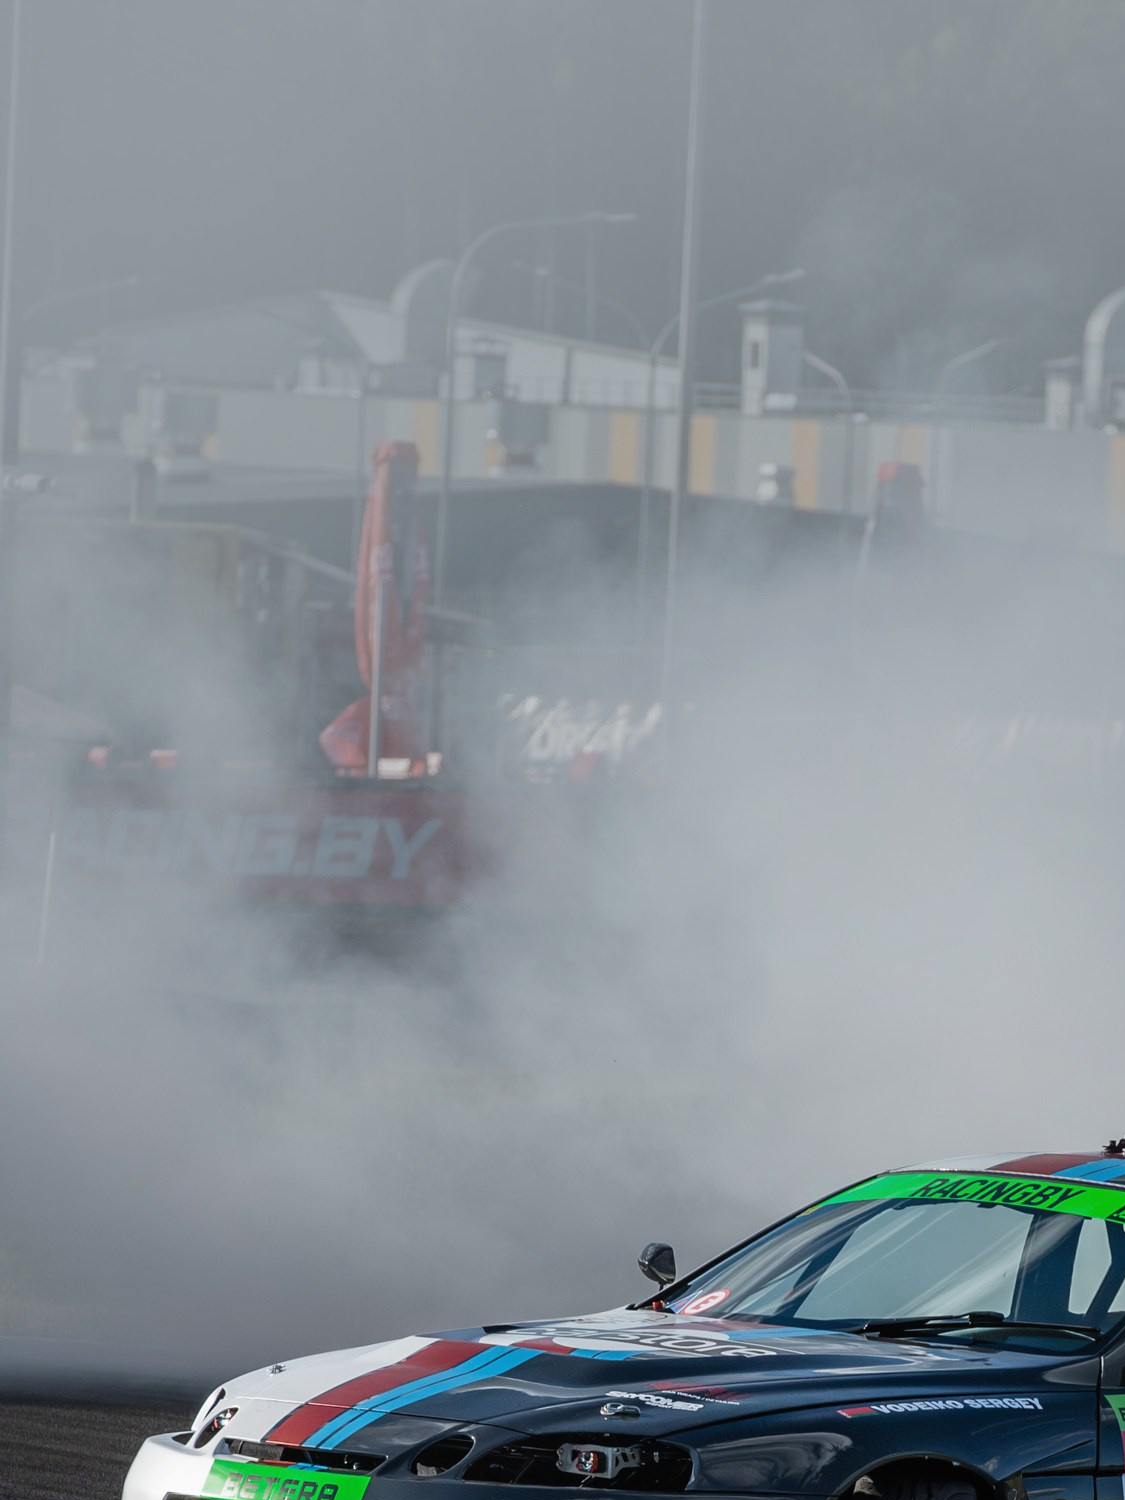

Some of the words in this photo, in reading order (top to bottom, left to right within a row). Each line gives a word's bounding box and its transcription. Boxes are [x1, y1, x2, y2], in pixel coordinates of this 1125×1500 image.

[909, 1178, 1086, 1209] RACINGBY
[871, 1400, 964, 1414] VODEIKO
[963, 1397, 1044, 1410] SERGEY
